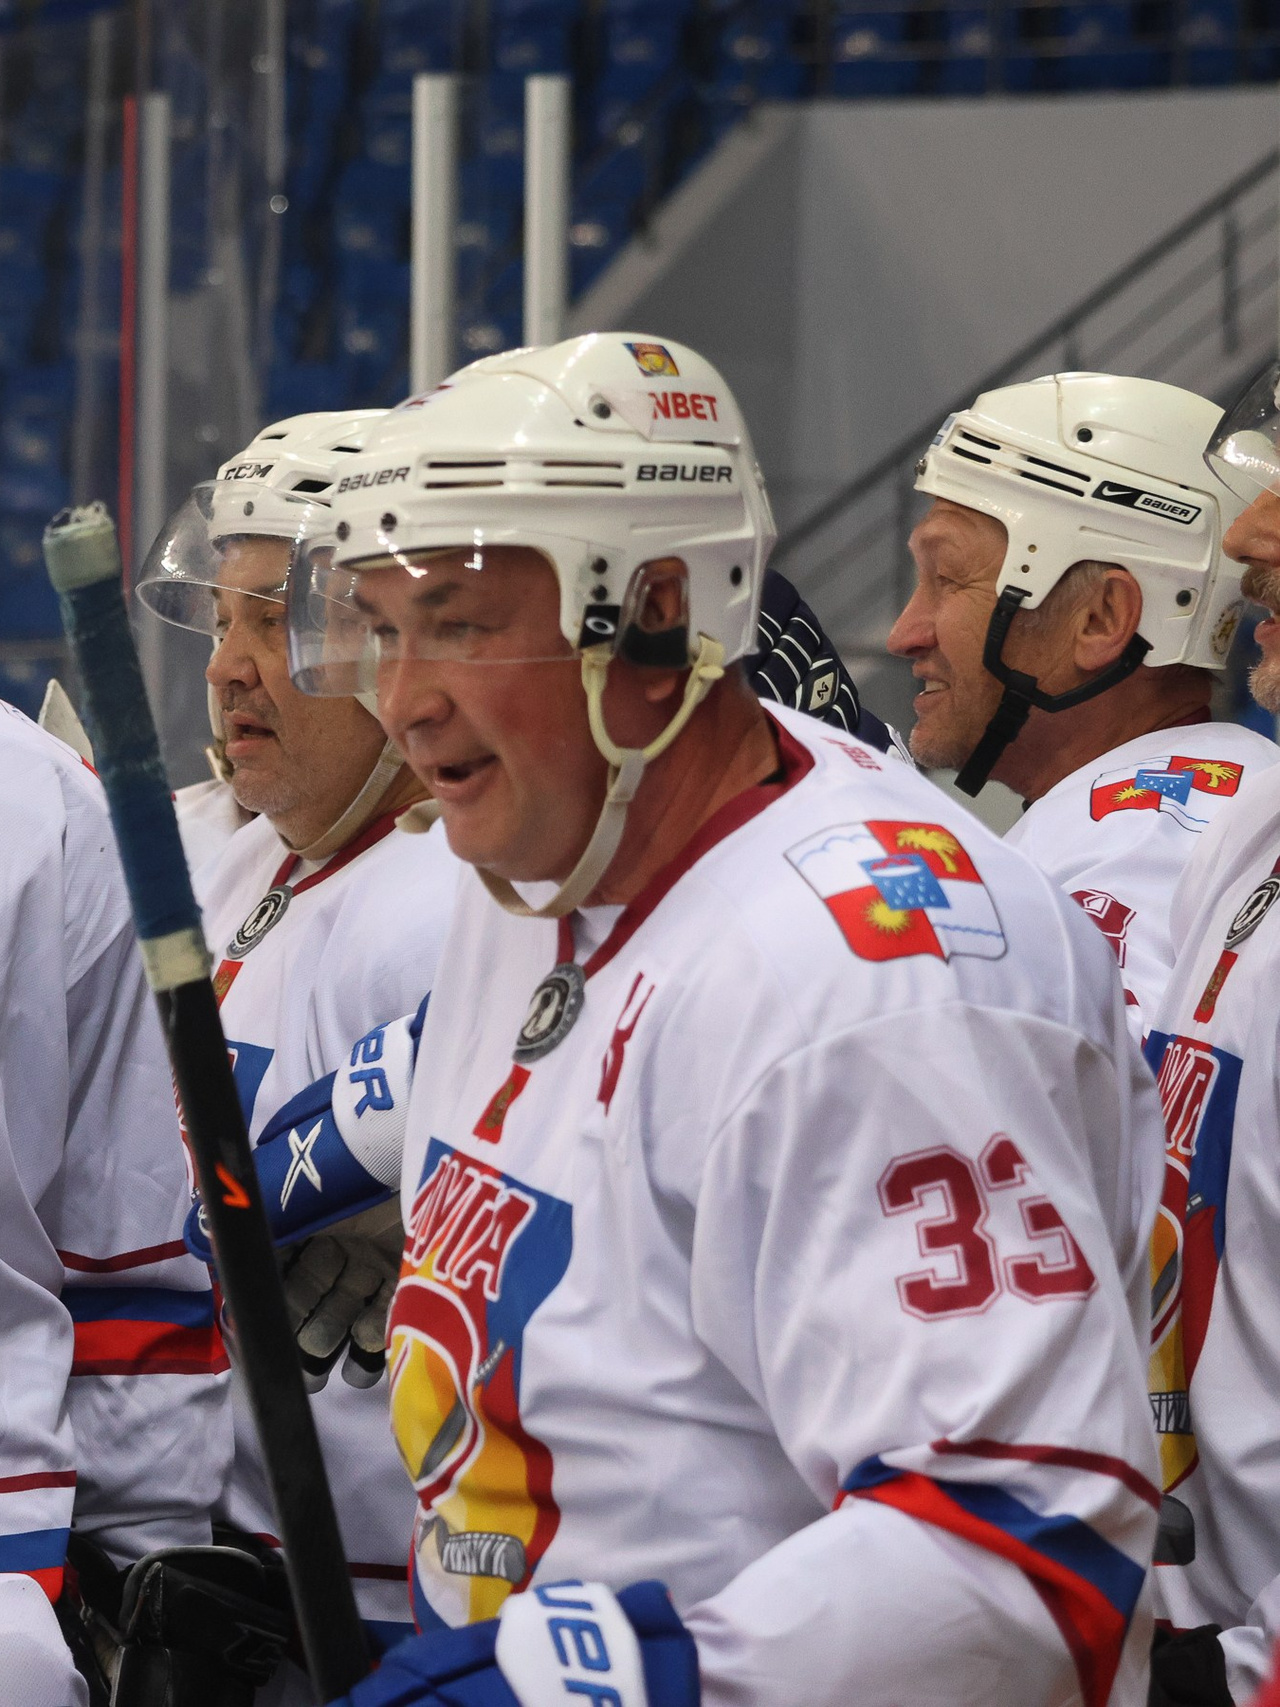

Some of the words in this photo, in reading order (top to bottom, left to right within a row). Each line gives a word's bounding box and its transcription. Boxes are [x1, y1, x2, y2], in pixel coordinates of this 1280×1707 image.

[225, 464, 274, 481] CCM
[337, 466, 410, 493] BAUER
[636, 464, 732, 484] BAUER
[1141, 497, 1191, 517] BAUER
[349, 1022, 394, 1119] ER
[877, 1131, 1100, 1323] 33
